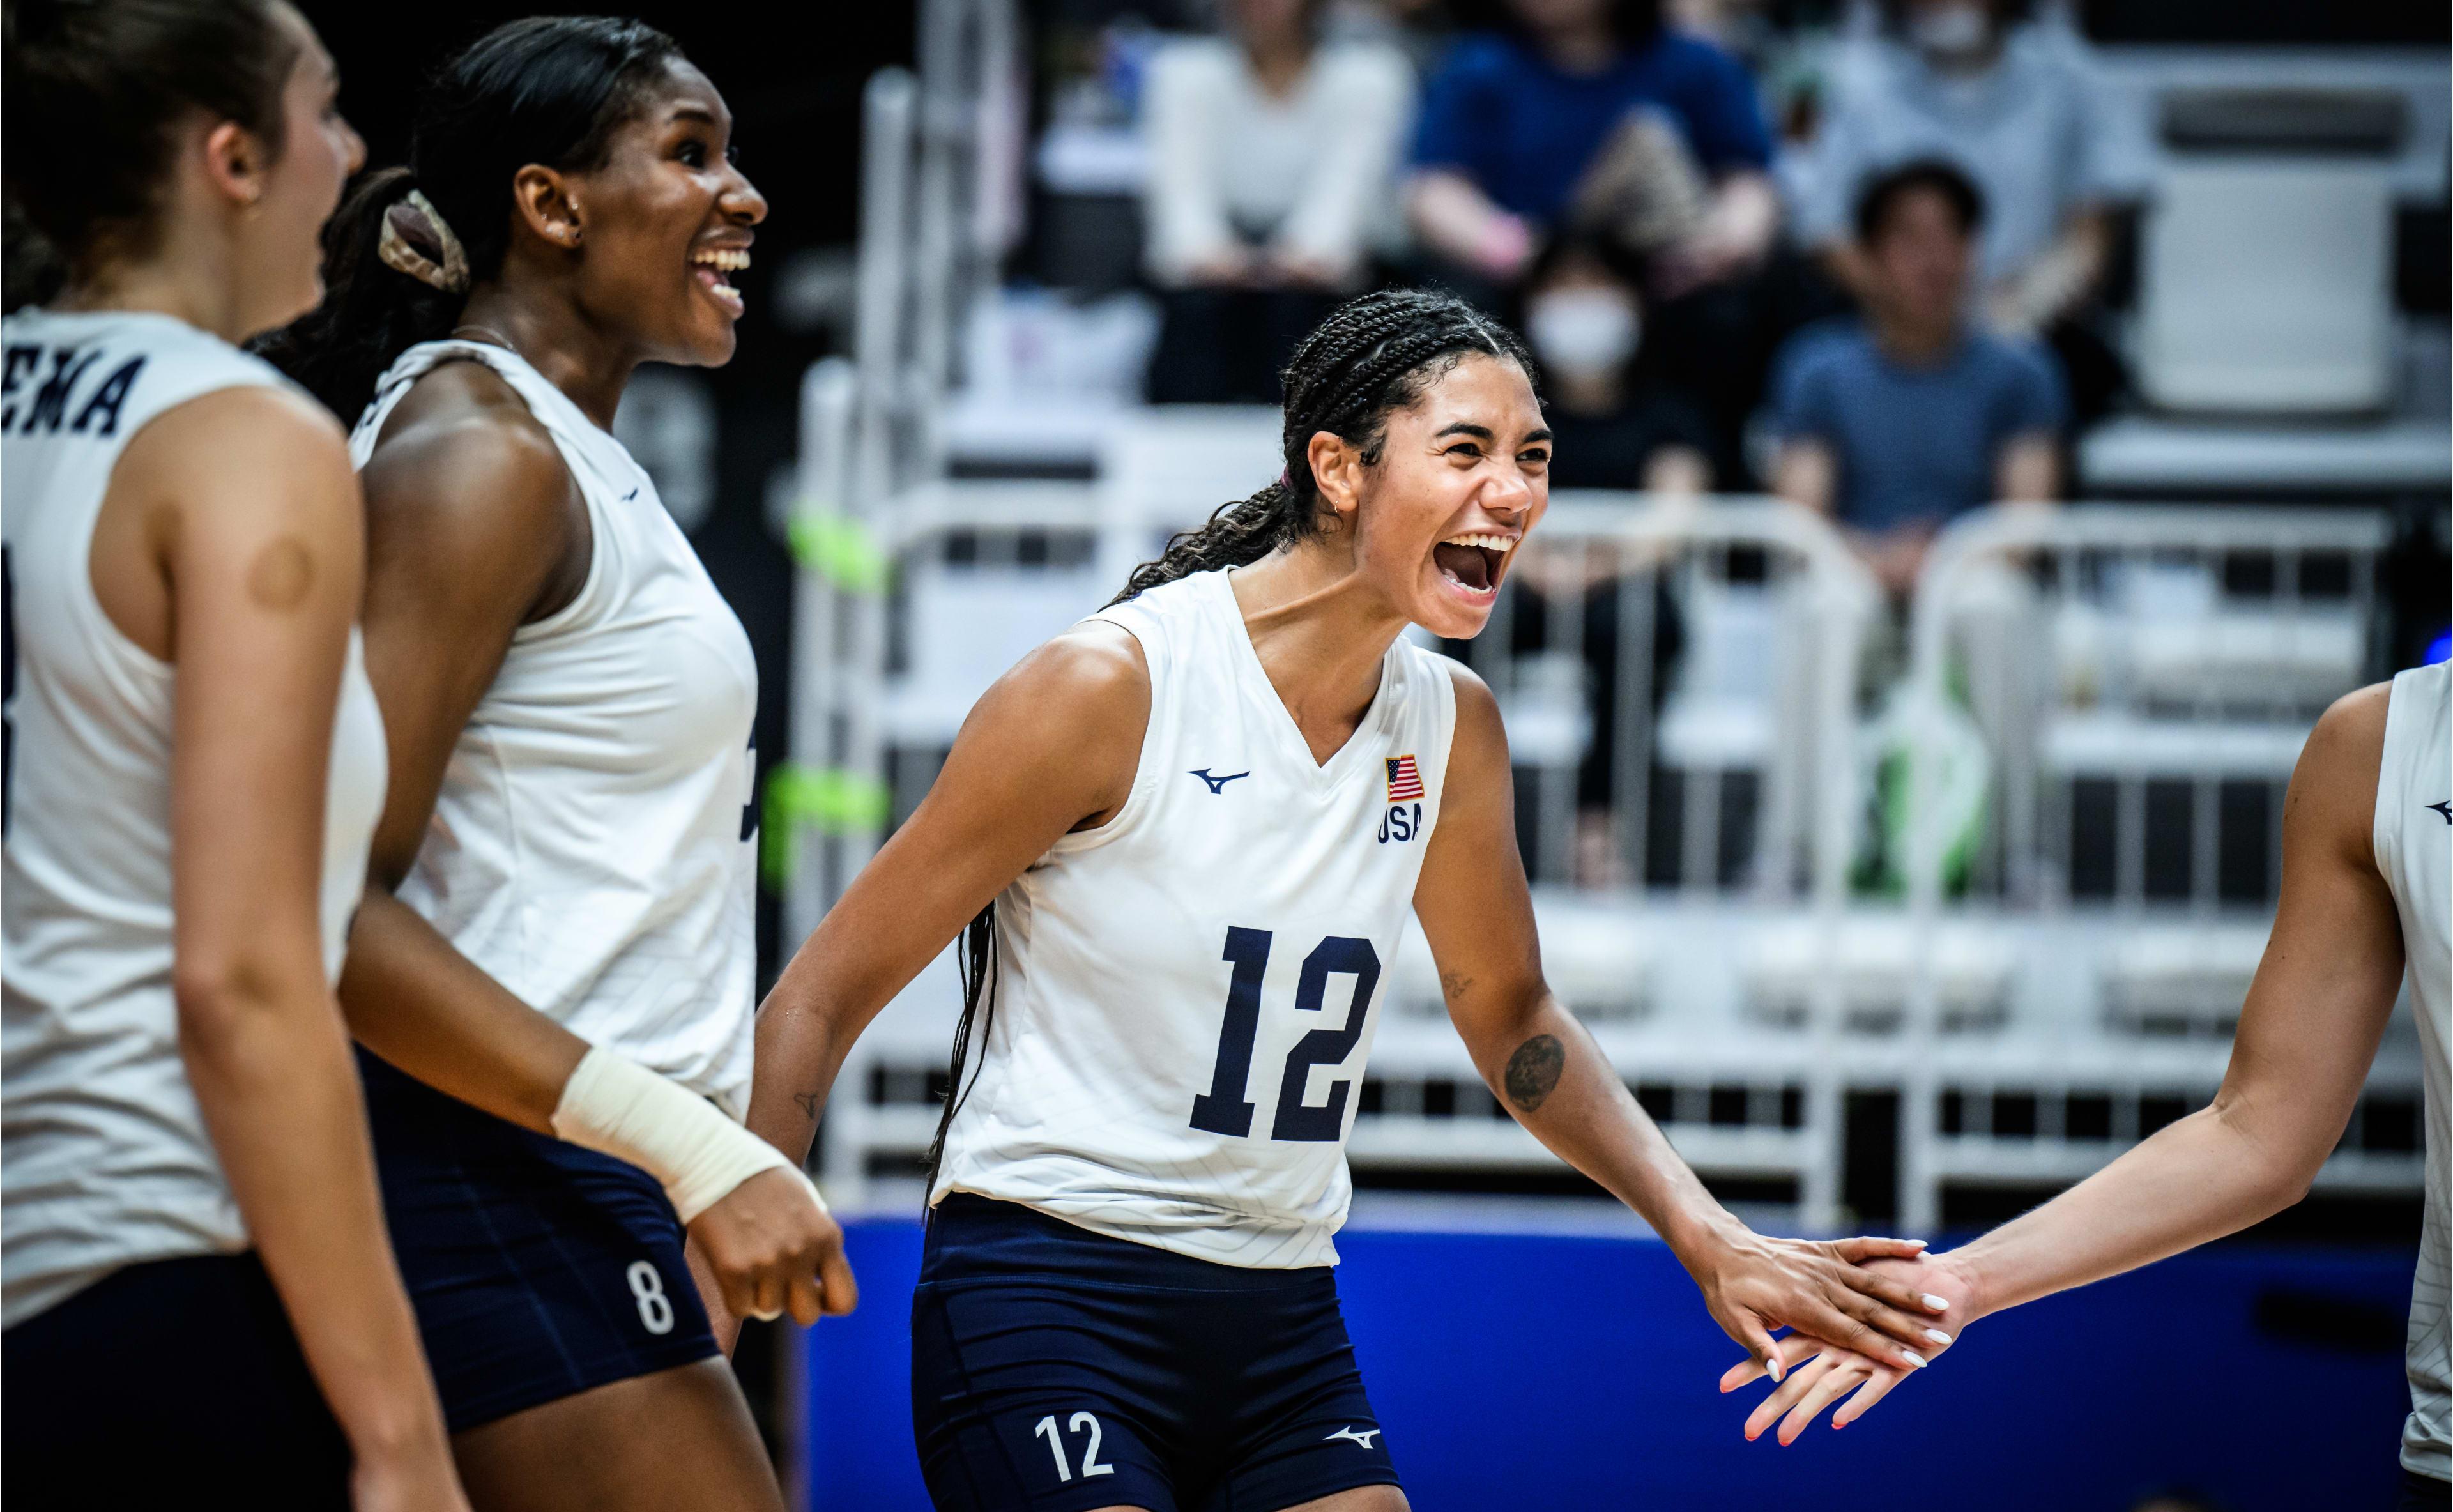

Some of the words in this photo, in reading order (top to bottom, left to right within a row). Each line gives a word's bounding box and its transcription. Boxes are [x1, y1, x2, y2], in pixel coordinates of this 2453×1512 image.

[1377, 802, 1422, 844] USA
[1188, 925, 1382, 1142] 12
[626, 1260, 675, 1335] 8
[1035, 1410, 1115, 1483] 12
